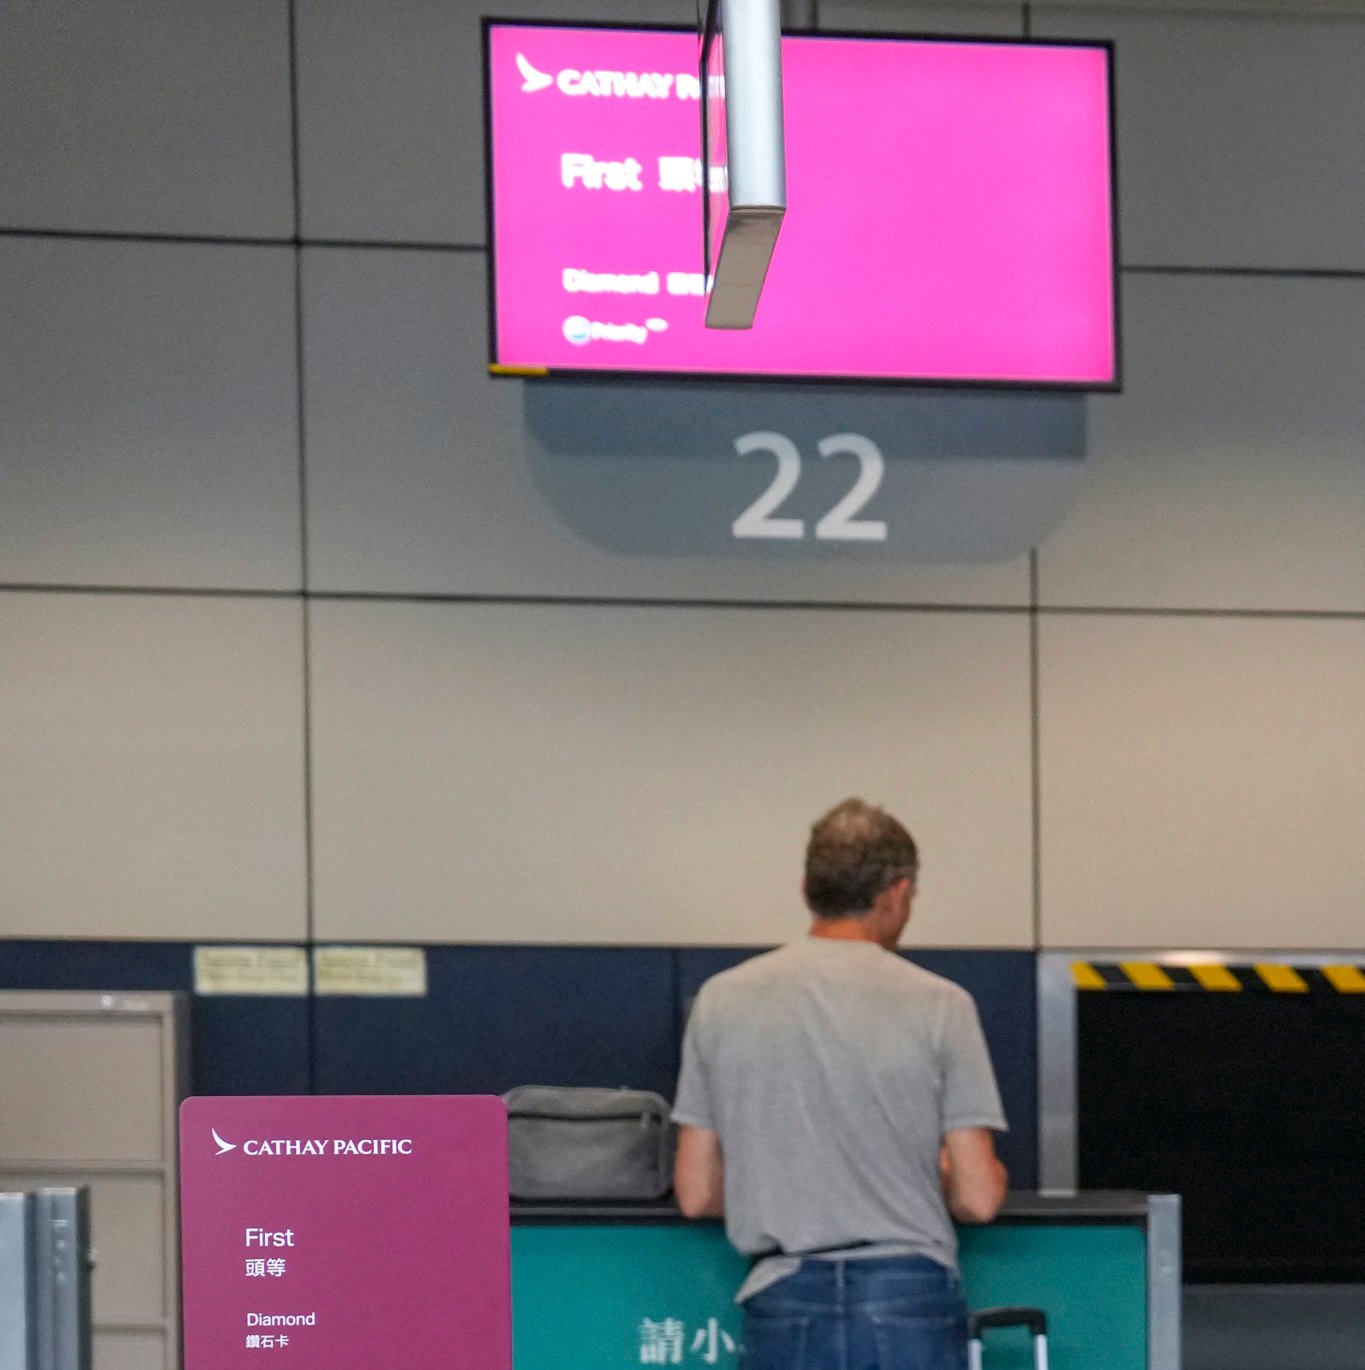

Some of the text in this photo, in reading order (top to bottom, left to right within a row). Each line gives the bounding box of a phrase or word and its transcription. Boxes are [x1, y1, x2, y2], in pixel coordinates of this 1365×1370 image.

[556, 69, 673, 98] CATHAY
[561, 153, 643, 191] First
[731, 431, 888, 541] 22
[244, 1140, 411, 1155] CATHAY PACIFIC
[246, 1228, 294, 1246] First
[246, 1258, 285, 1277] 頭等
[247, 1312, 315, 1326] Diamond
[246, 1335, 288, 1348] 鑽石卡
